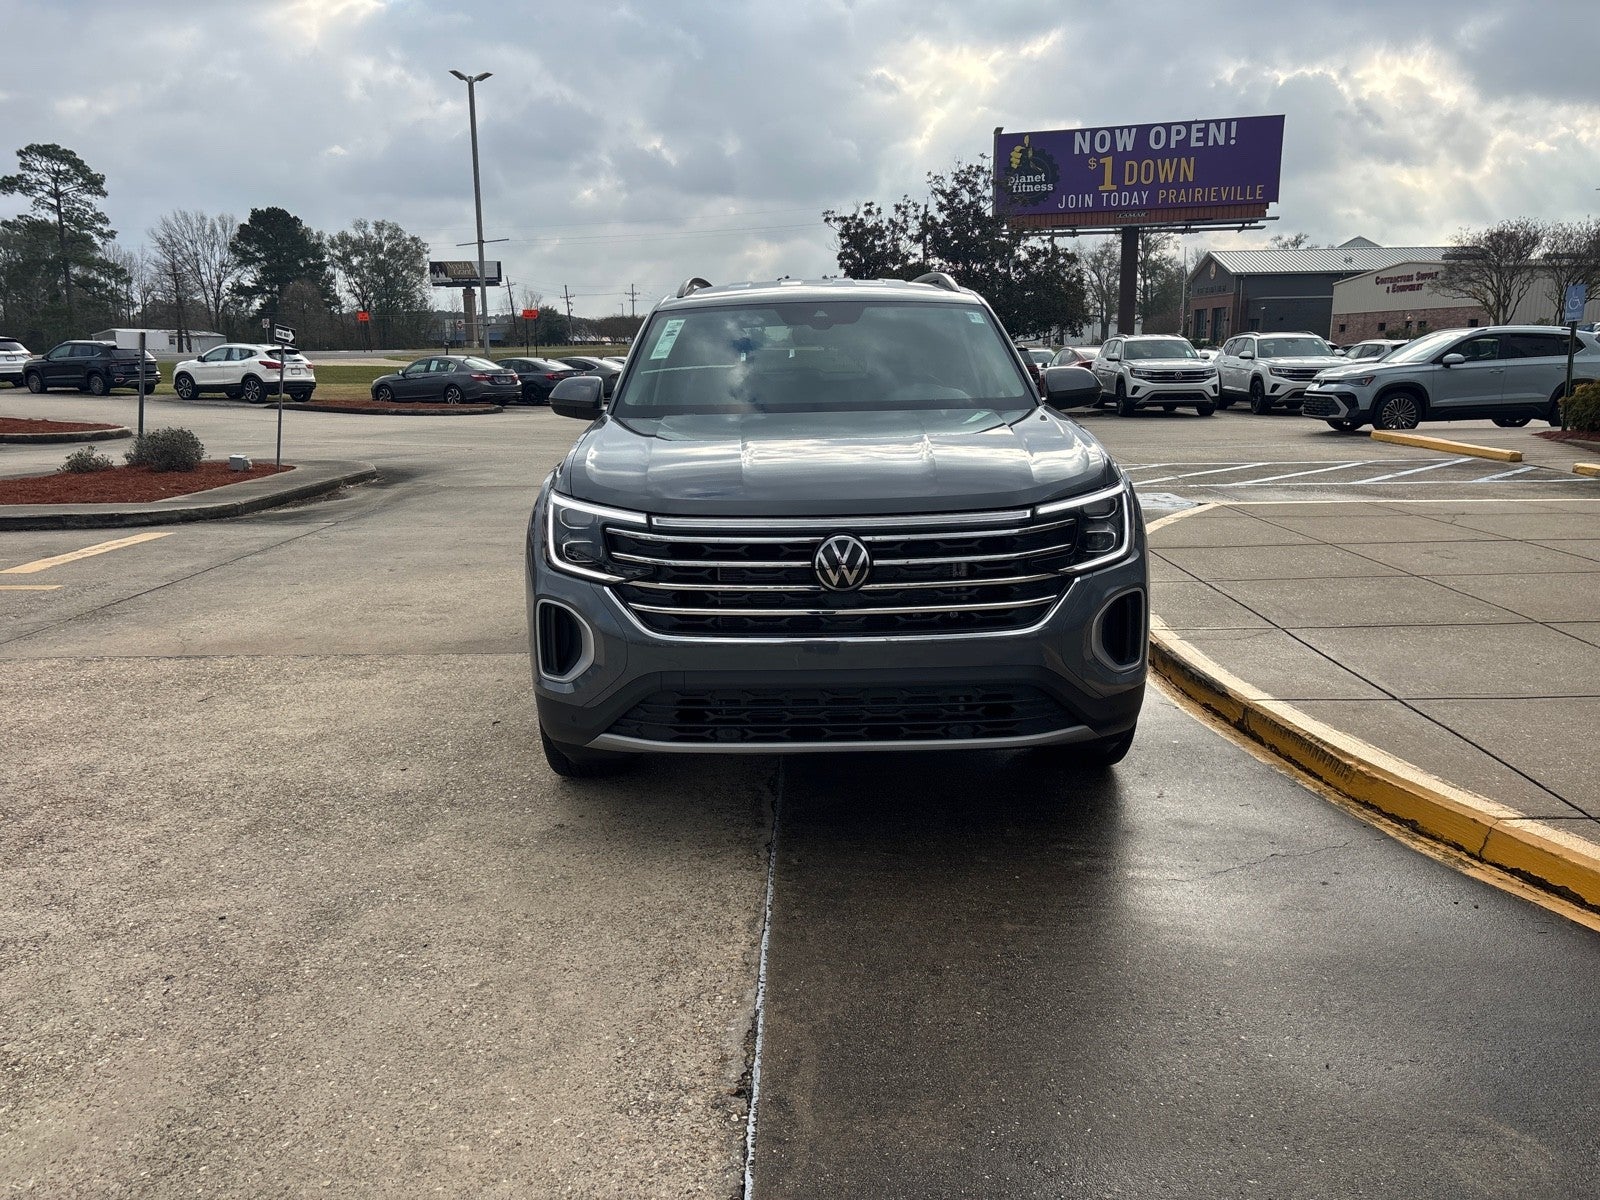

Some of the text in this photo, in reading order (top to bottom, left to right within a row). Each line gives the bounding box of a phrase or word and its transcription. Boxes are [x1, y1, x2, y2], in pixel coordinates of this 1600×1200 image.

[1074, 121, 1238, 155] NOW OPEN!
[1008, 172, 1046, 187] planet
[1088, 156, 1196, 191] $1 DOWN
[1012, 182, 1054, 193] fitness
[1057, 184, 1265, 209] JOIN TODAY PRAIRIEVILLE
